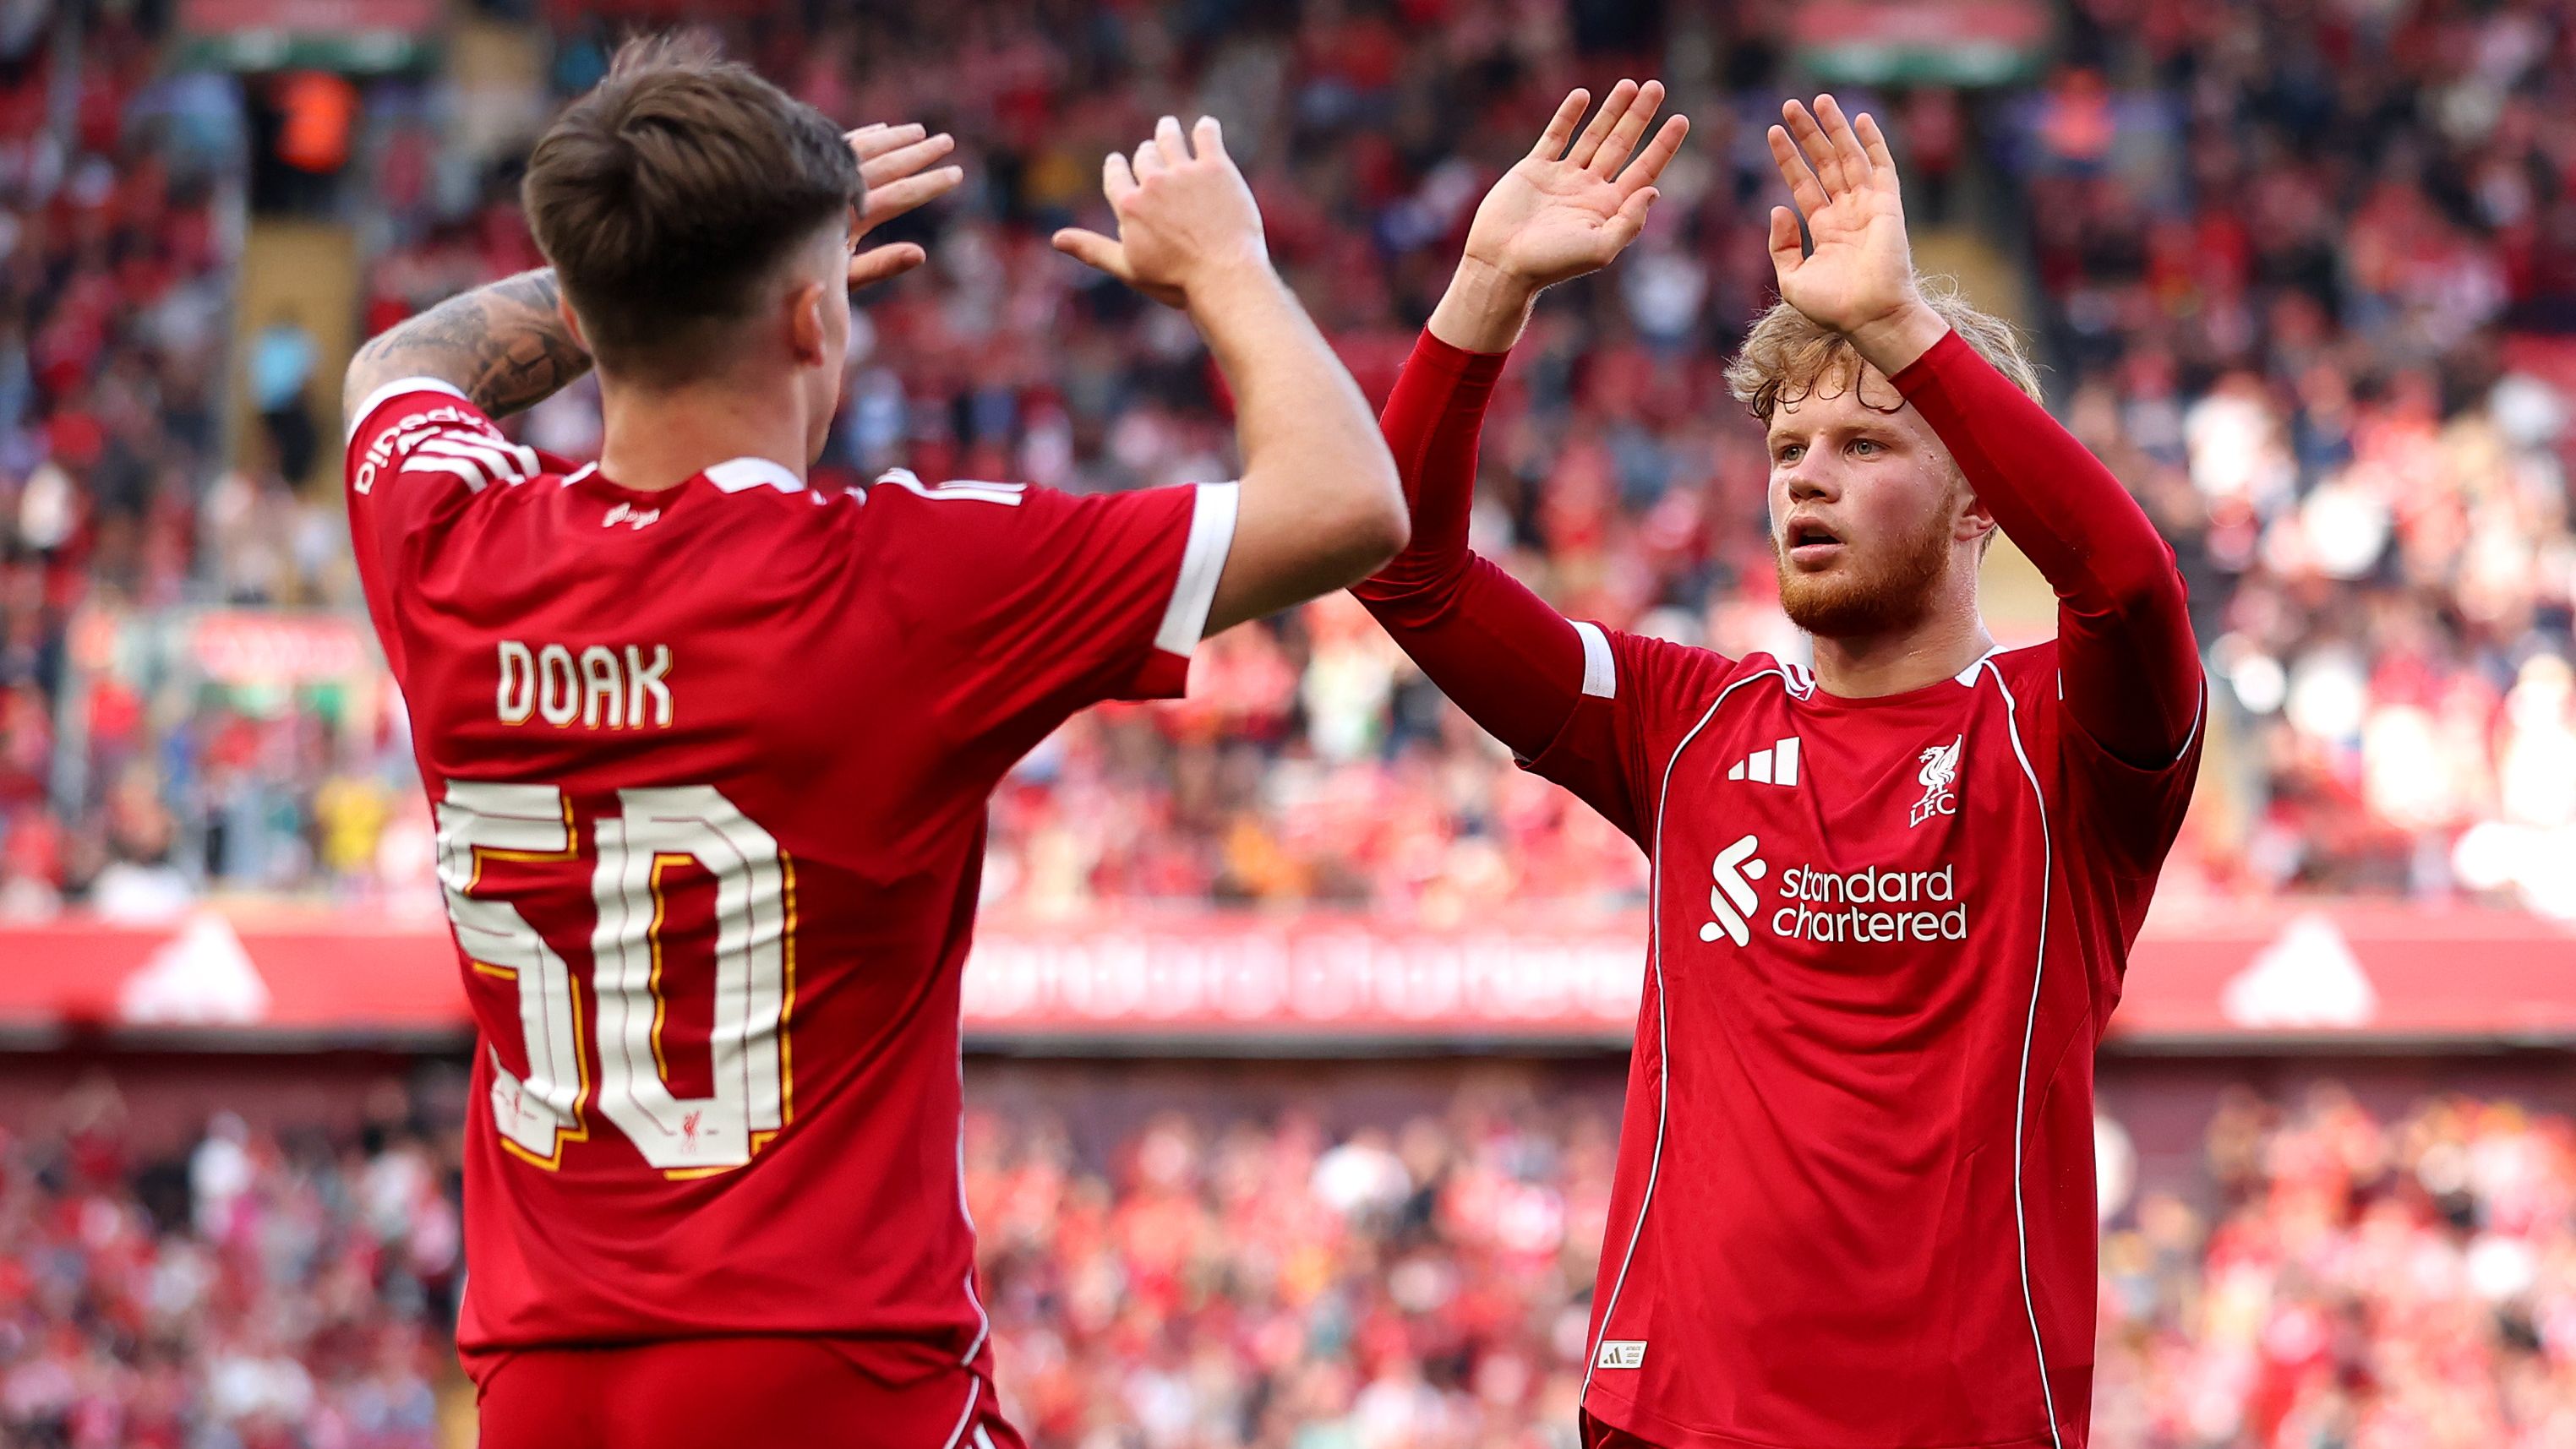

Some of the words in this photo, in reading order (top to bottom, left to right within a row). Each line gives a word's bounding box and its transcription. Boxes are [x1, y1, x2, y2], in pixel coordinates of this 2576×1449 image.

[496, 640, 673, 730] DOAK
[1779, 863, 1954, 903] standard
[1771, 902, 1967, 943] chartered
[437, 779, 796, 1179] 50
